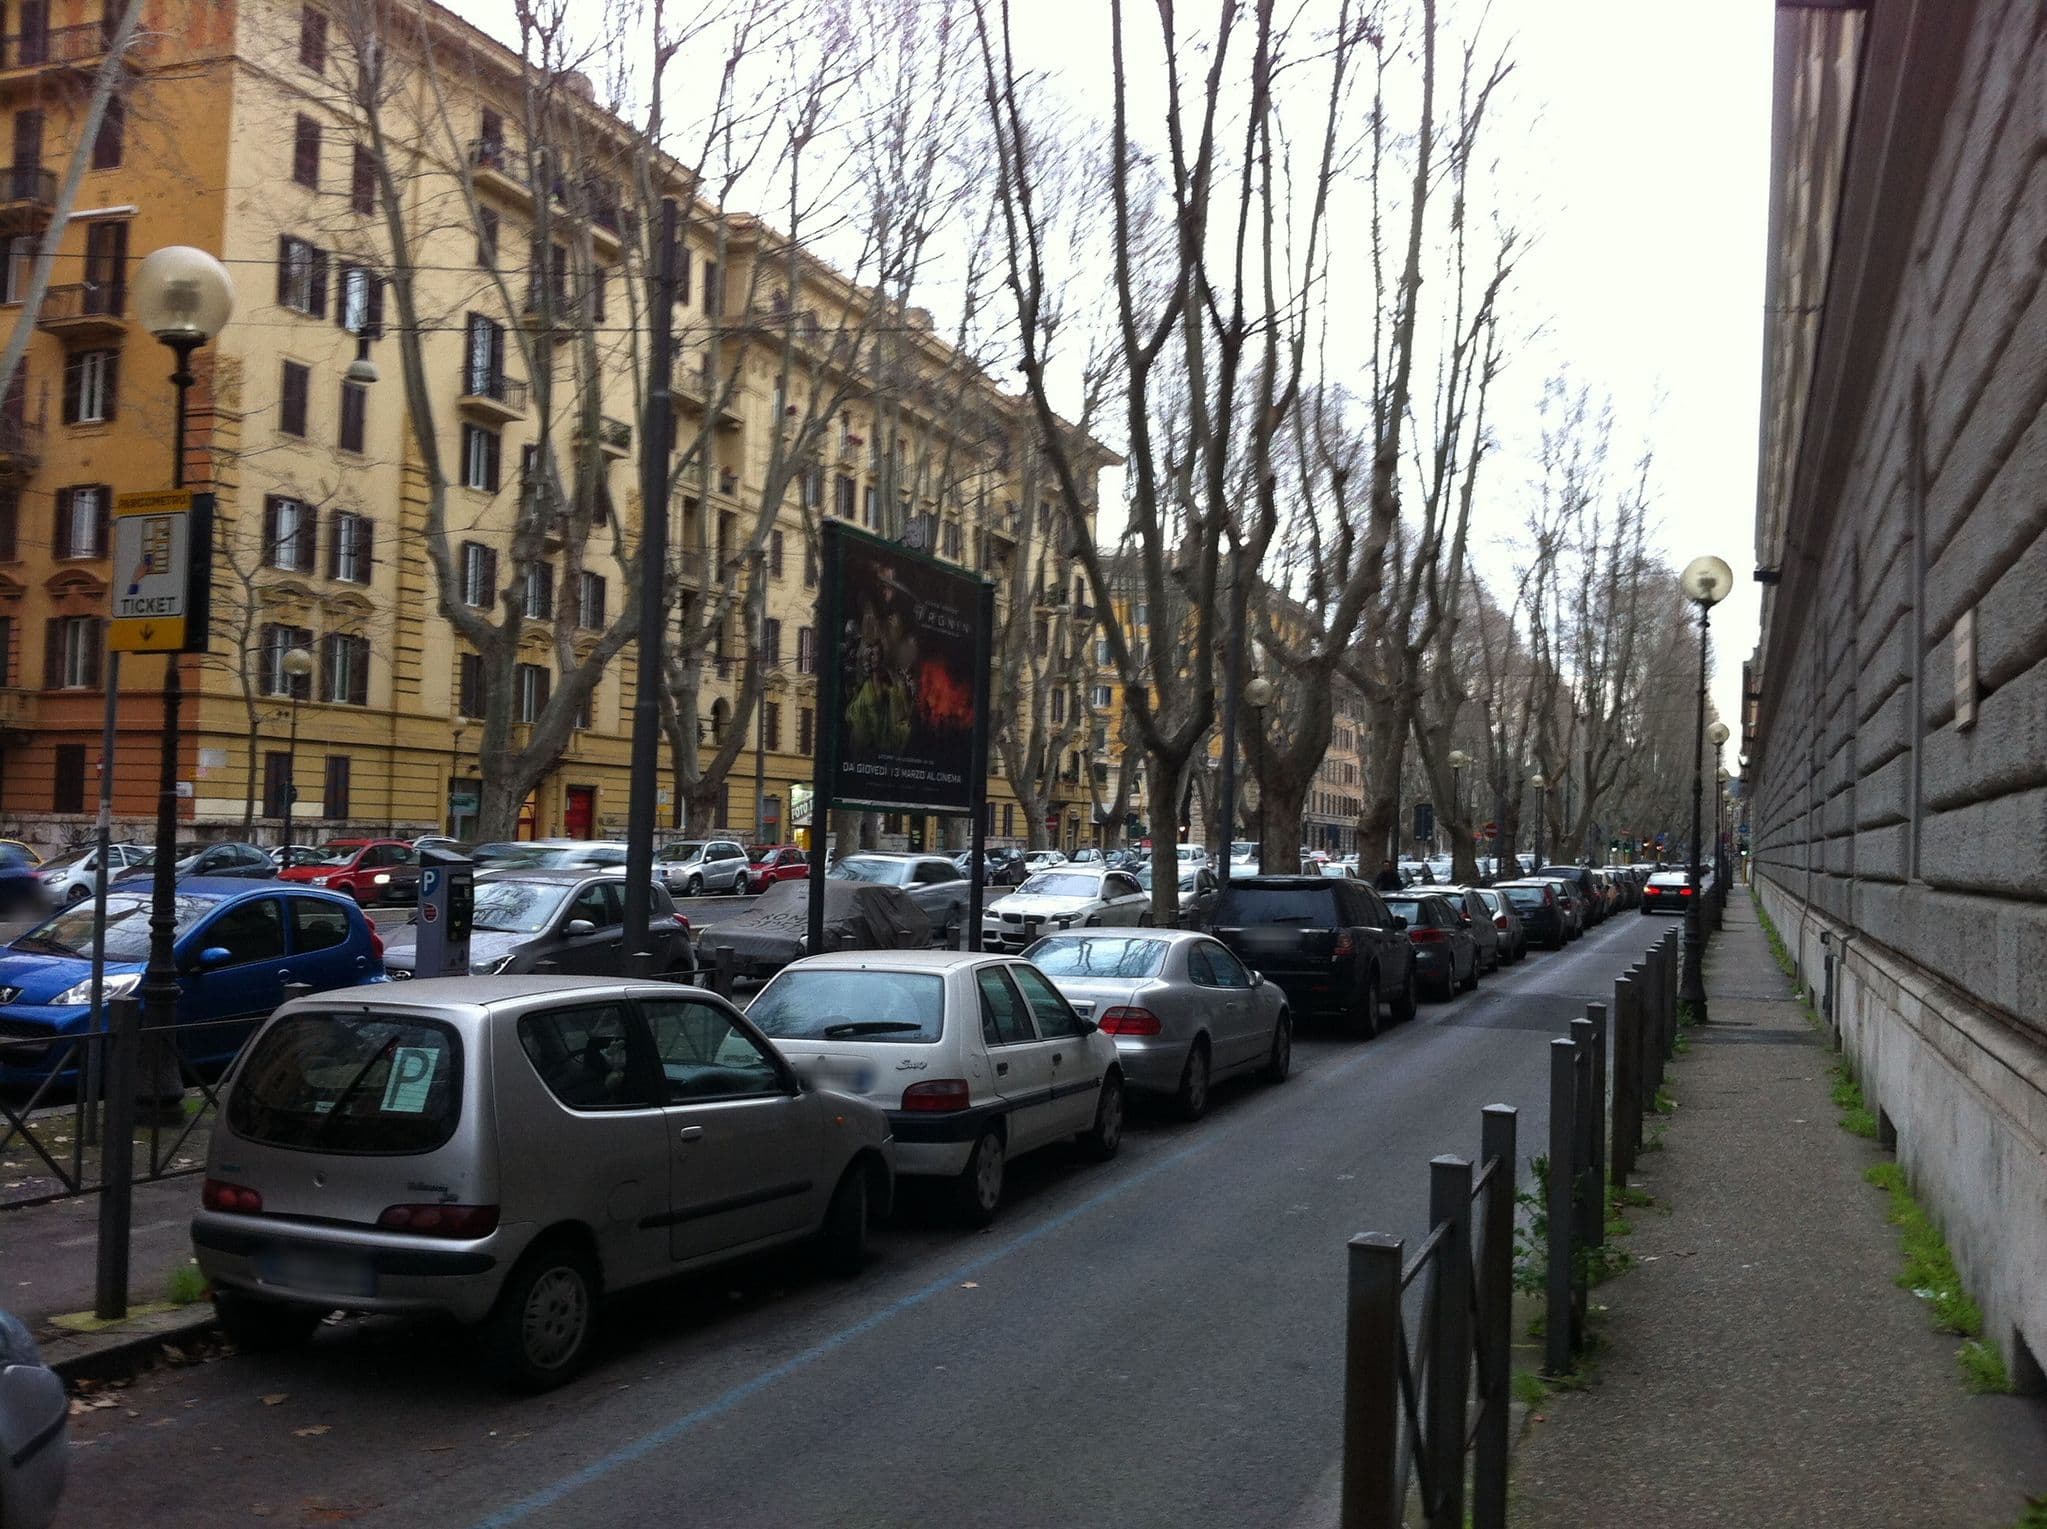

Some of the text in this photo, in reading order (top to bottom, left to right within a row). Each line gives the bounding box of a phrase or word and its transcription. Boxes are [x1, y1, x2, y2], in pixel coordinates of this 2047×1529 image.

[120, 596, 176, 614] TICKET
[842, 761, 855, 773] DA
[890, 767, 900, 777] 13
[901, 769, 925, 780] MARZO
[926, 771, 936, 781] AL
[936, 772, 962, 784] CINEMA
[791, 802, 808, 820] FOTO
[423, 870, 435, 892] P
[387, 1049, 430, 1109] P
